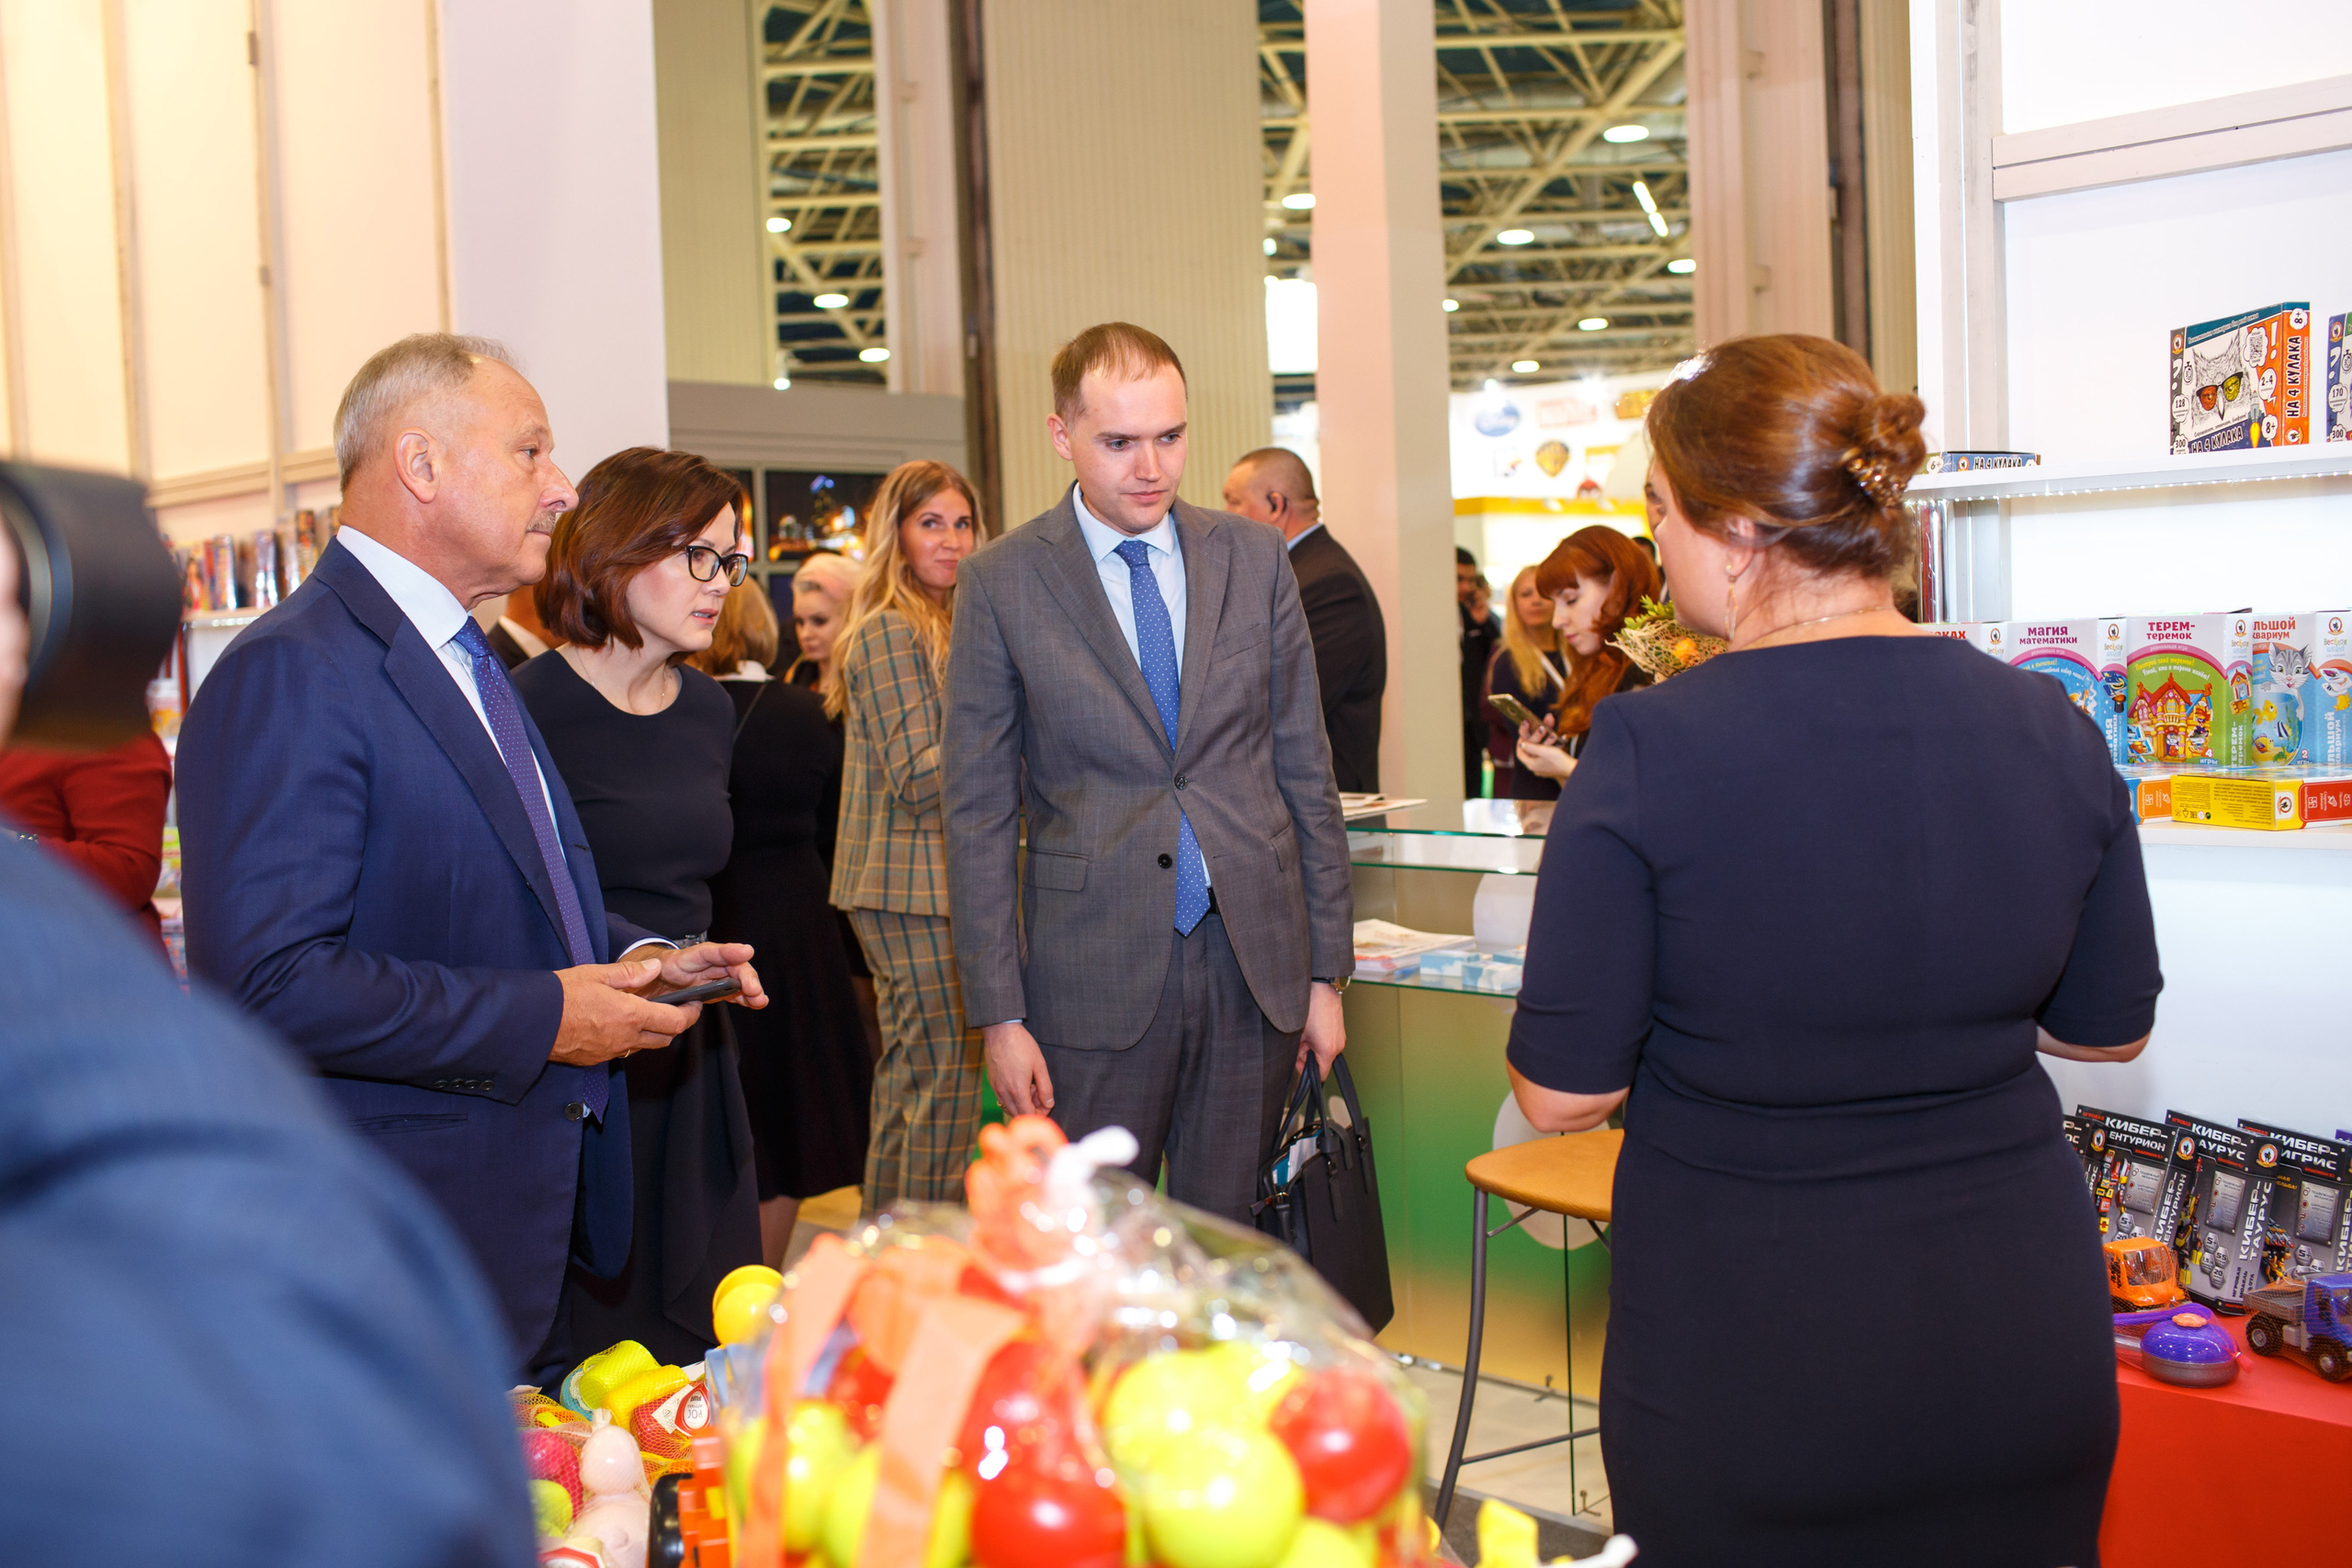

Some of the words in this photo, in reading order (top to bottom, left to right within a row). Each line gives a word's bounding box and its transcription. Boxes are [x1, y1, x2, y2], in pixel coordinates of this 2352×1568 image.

[2286, 335, 2302, 386] КУЛАКА
[2261, 375, 2274, 387] 2-4
[2288, 389, 2300, 398] 4
[2332, 388, 2344, 398] 170
[2175, 398, 2186, 409] 128
[2286, 401, 2301, 418] НА
[2266, 421, 2276, 434] 8+
[2332, 429, 2344, 438] 300
[2176, 438, 2187, 448] 300
[2191, 441, 2202, 453] НА
[2204, 438, 2211, 450] 4
[2211, 426, 2244, 449] КУЛАКА
[1930, 460, 1941, 470] 6+
[1973, 457, 1984, 470] НА
[1986, 457, 1991, 468] 4
[1994, 457, 2021, 469] КУЛАКА
[2148, 621, 2195, 632] ТЕРЕМ-
[2253, 616, 2296, 630] льшой
[2028, 626, 2068, 637] магия
[2146, 632, 2192, 641] теремок
[2253, 631, 2290, 640] квариум
[2019, 636, 2078, 645] математики
[2205, 748, 2213, 758] 4
[2301, 750, 2308, 759] 2
[2105, 1116, 2168, 1139] КИБЕР-
[2191, 1122, 2248, 1147] КИБЕР-
[2109, 1131, 2166, 1152] ЕНТУРИОН
[2269, 1132, 2338, 1156] КИБЕР-
[2199, 1139, 2246, 1161] АУРУС
[2281, 1149, 2337, 1170] ИГРИС
[2154, 1171, 2178, 1242] КИБЕР-
[2163, 1173, 2187, 1246] ЕНТУРИОН
[2120, 1217, 2132, 1227] 5+
[2239, 1180, 2261, 1261] КИБЕР-
[2249, 1181, 2272, 1261] ТАУРУС
[2207, 1236, 2217, 1246] 5+
[2299, 1249, 2311, 1258] 5+
[2233, 1267, 2241, 1297] ИГРОВАЯ
